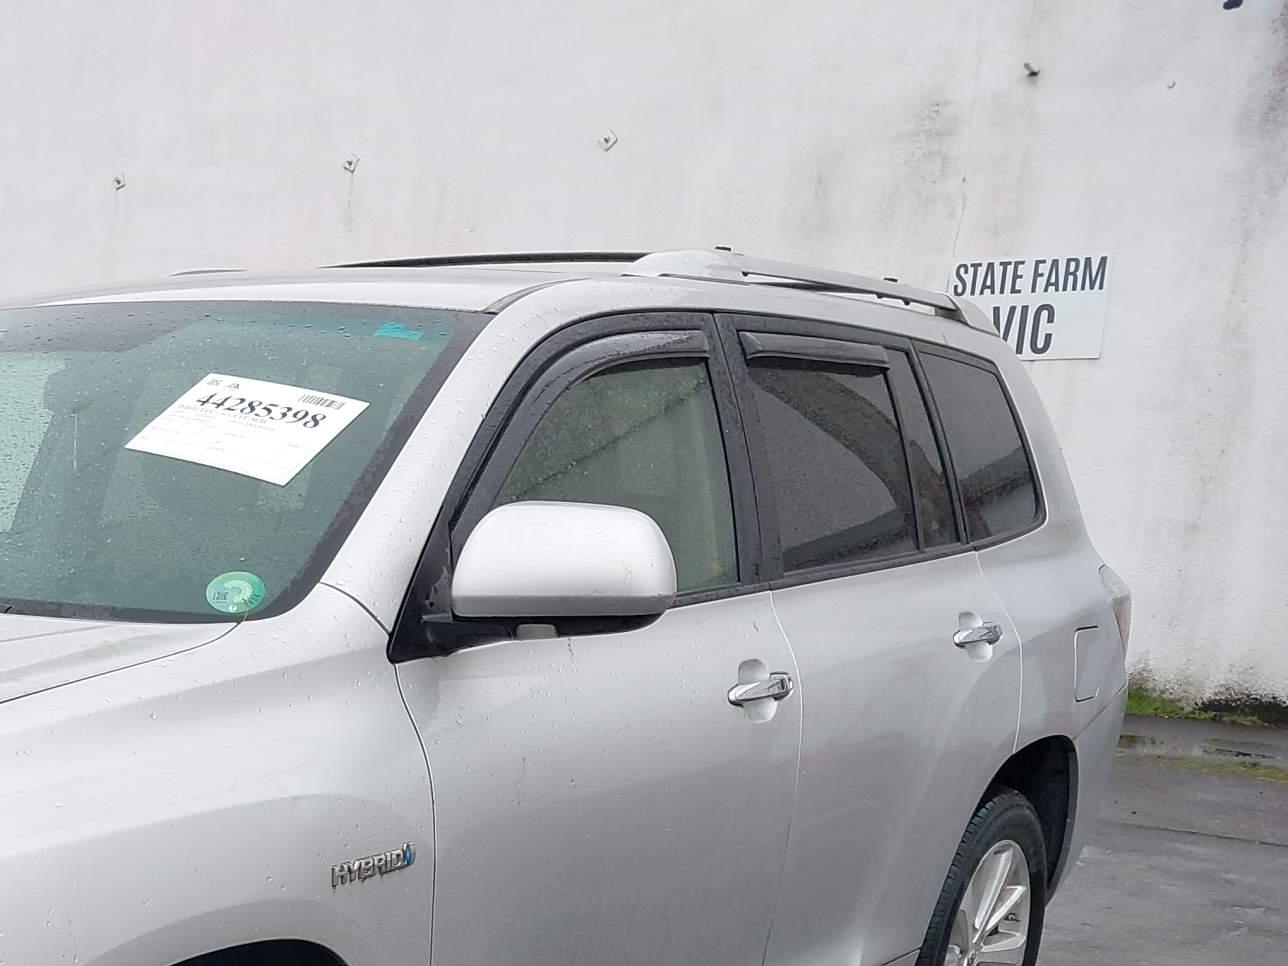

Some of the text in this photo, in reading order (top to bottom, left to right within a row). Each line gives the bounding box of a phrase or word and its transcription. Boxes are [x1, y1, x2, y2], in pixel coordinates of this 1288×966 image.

[953, 256, 1108, 297] STATE FARM
[992, 303, 1056, 355] VIC
[196, 393, 327, 429] 44285398
[331, 848, 403, 887] HYBRID
